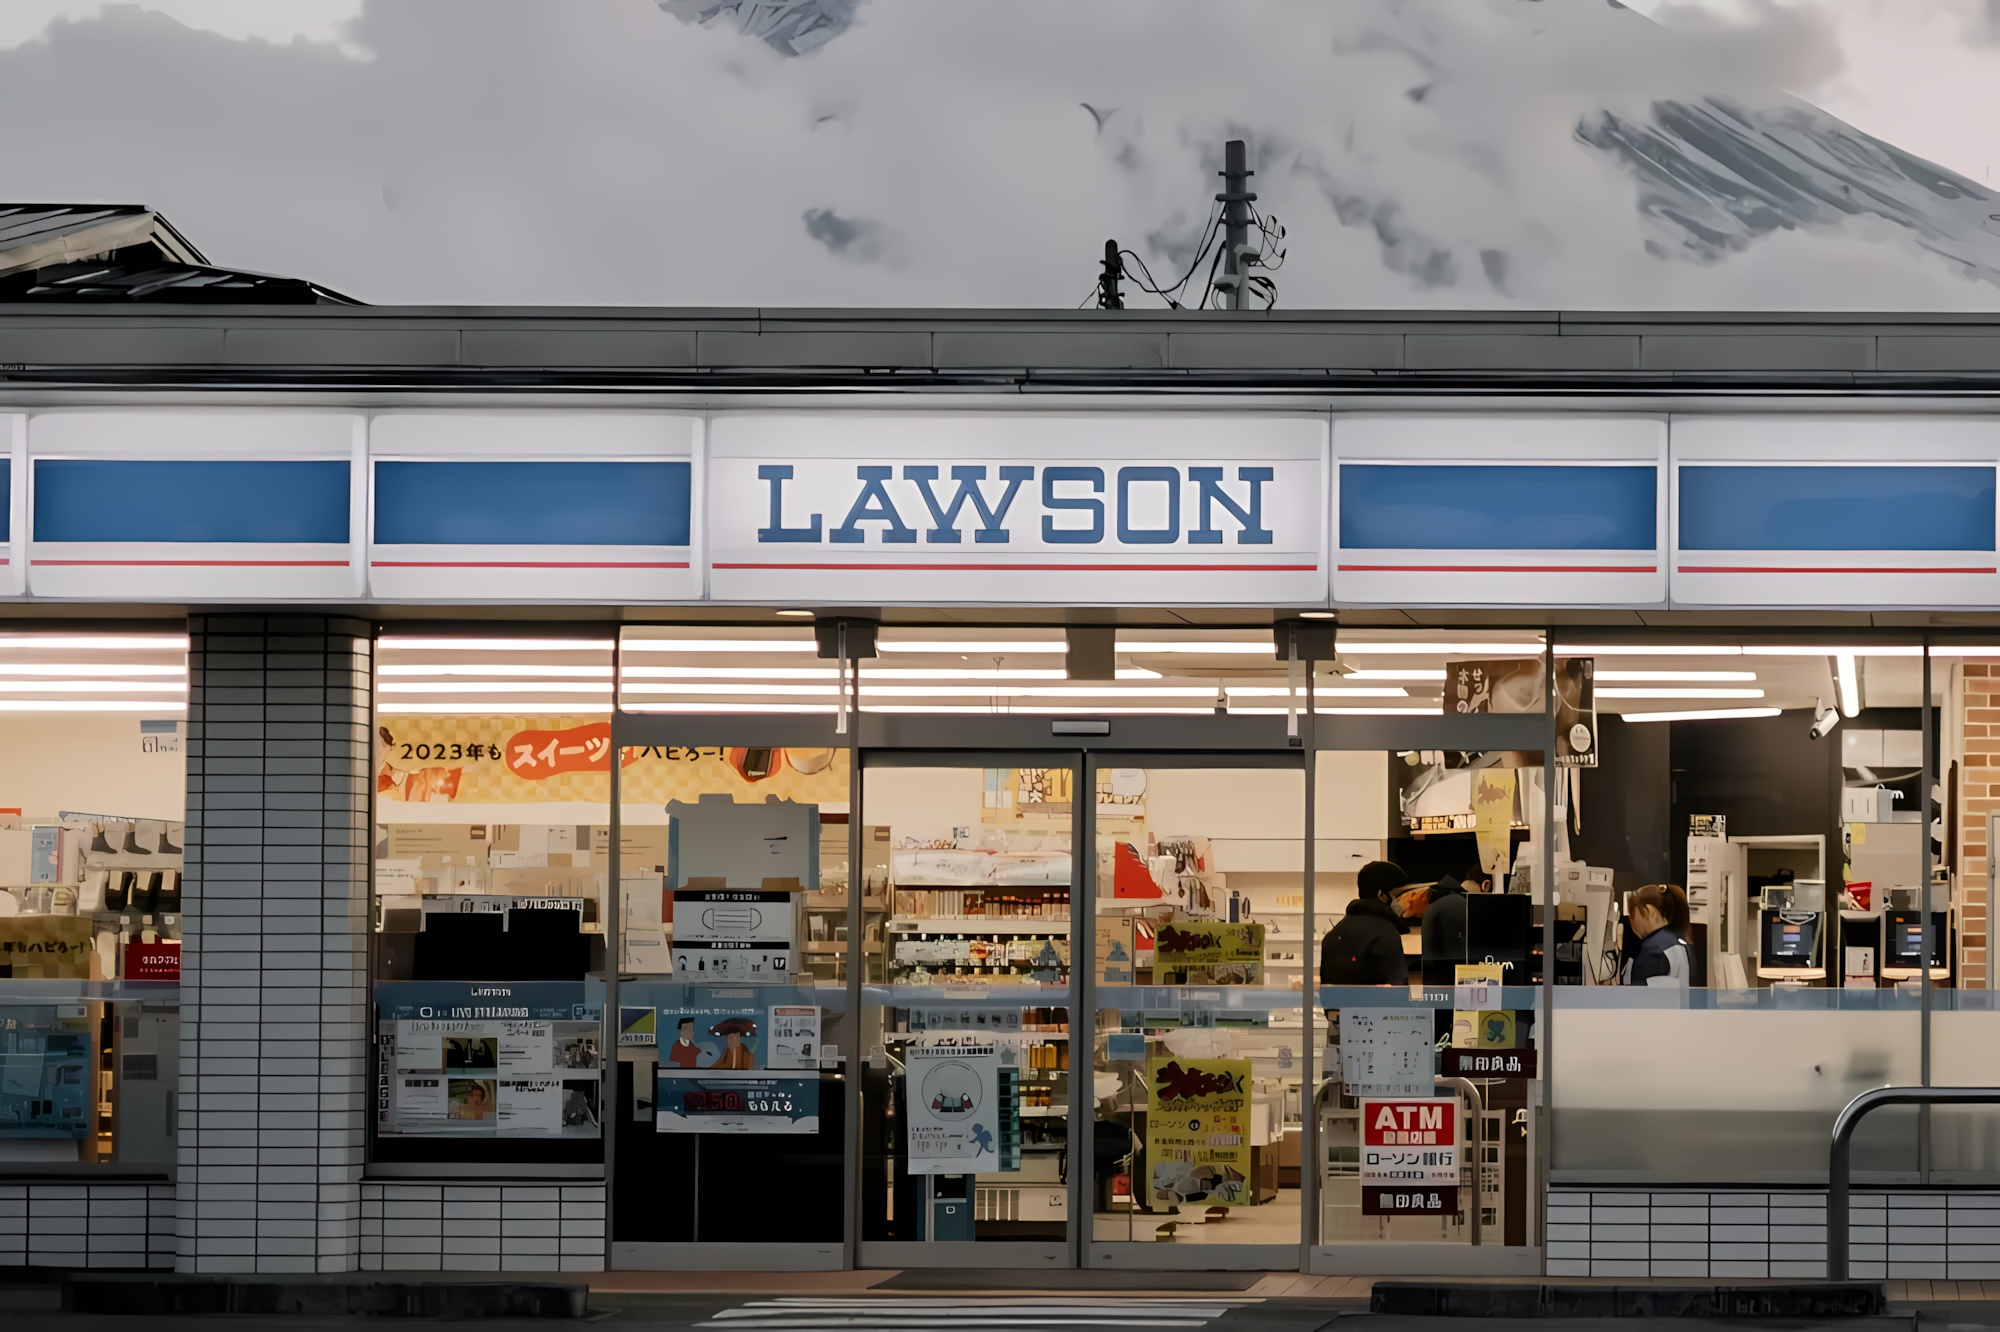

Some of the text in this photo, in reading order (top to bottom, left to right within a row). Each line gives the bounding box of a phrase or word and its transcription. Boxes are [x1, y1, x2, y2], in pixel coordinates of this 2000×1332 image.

[758, 465, 1273, 544] LAWSON
[1375, 1106, 1443, 1130] ATM
[1367, 1152, 1453, 1166] ローソン行
